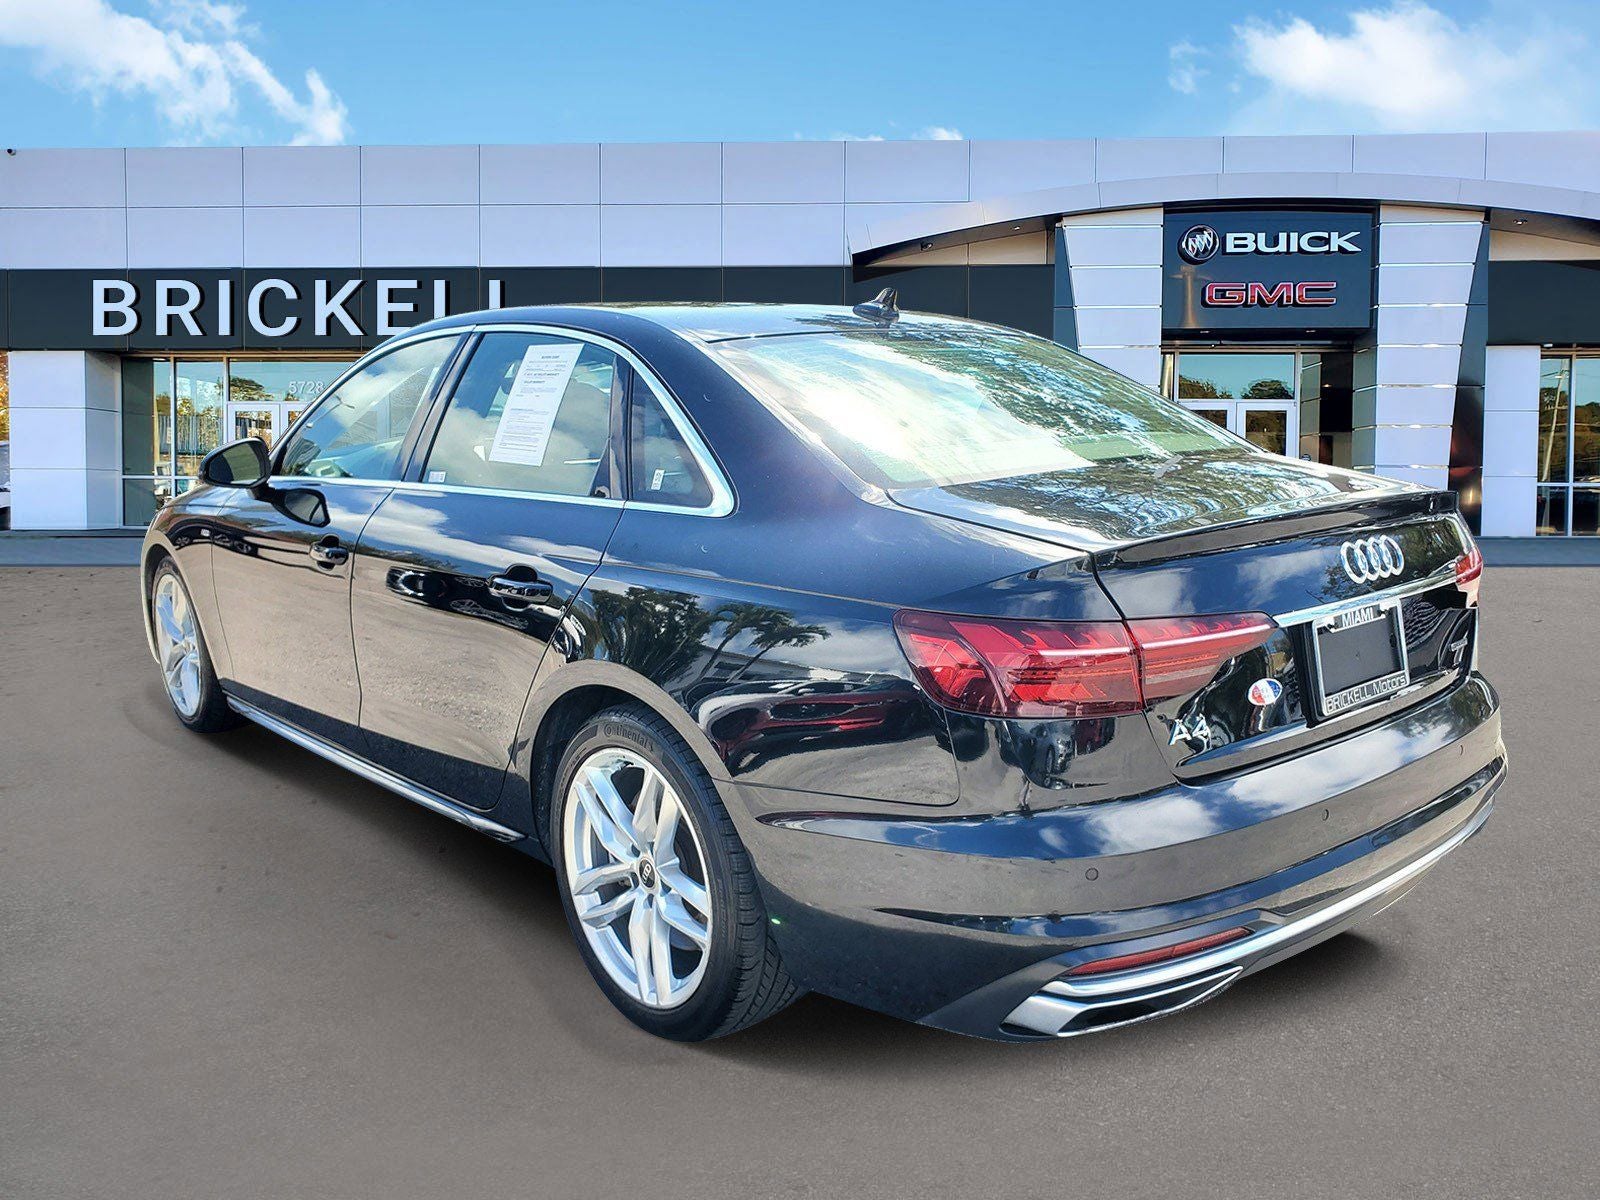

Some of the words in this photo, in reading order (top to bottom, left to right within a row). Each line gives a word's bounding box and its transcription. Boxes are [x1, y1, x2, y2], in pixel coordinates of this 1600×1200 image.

[1225, 231, 1362, 253] BUICK
[1205, 281, 1337, 305] GMC
[288, 380, 326, 396] 5728
[1341, 606, 1374, 628] MIAMI
[1326, 685, 1371, 713] BRICKELL
[1372, 675, 1406, 695] Motors
